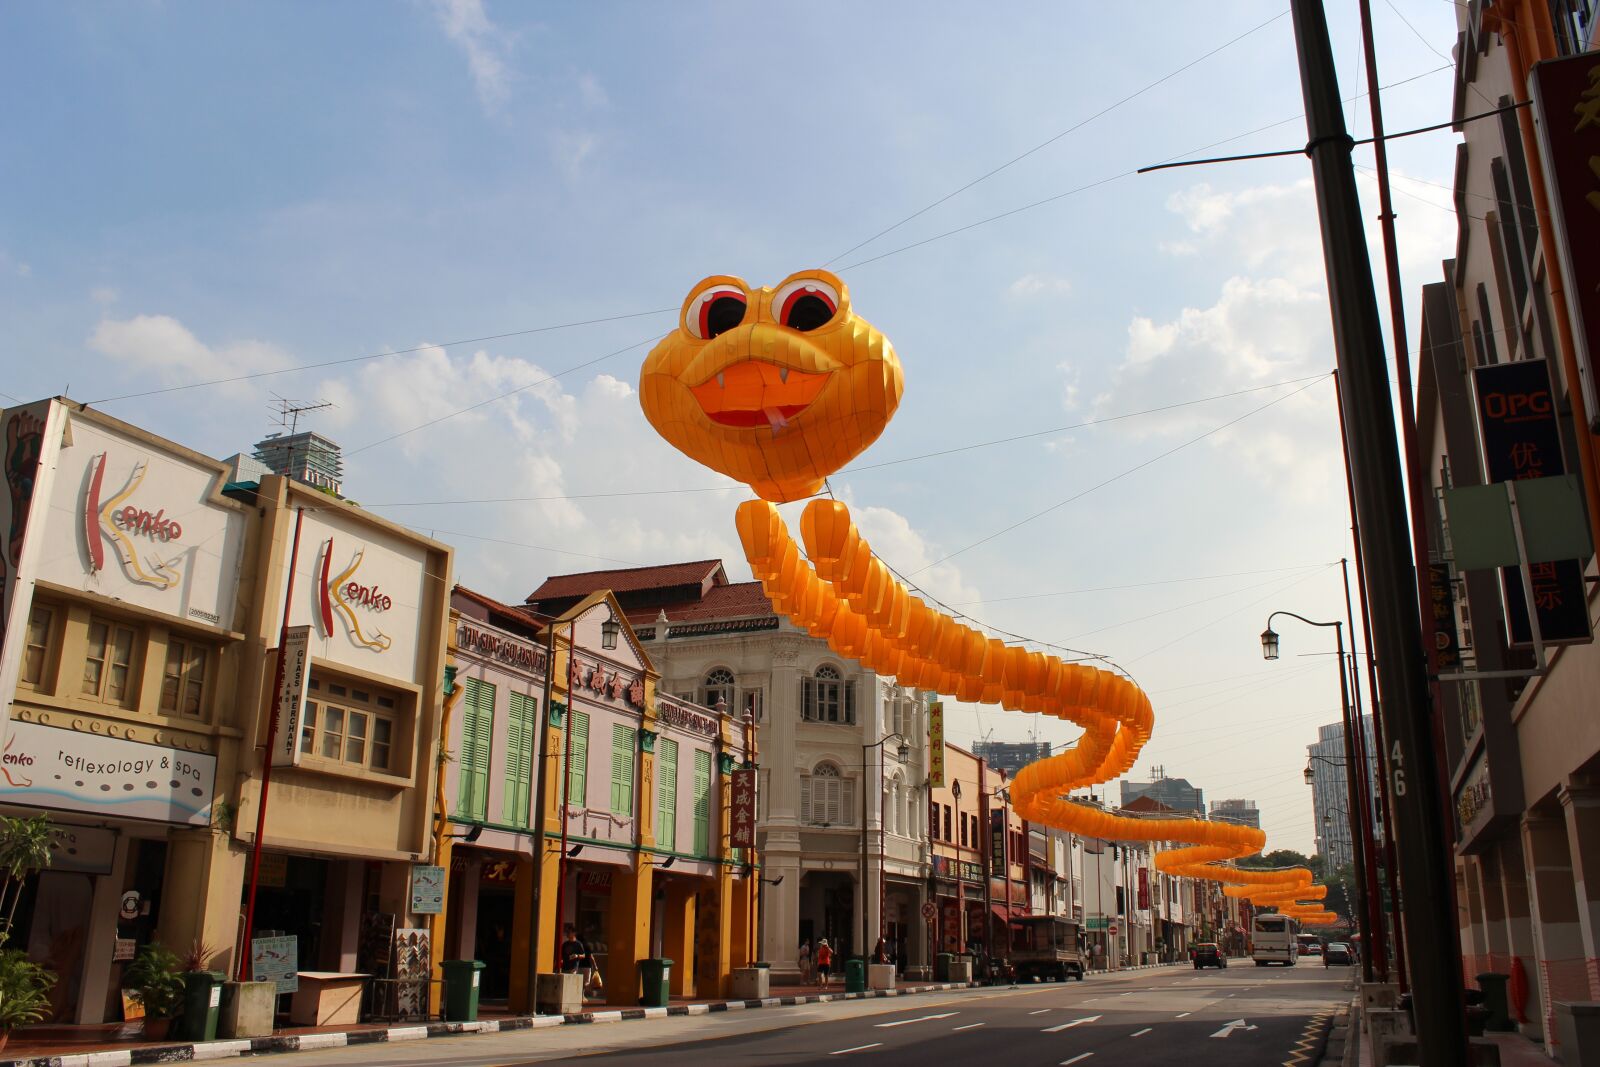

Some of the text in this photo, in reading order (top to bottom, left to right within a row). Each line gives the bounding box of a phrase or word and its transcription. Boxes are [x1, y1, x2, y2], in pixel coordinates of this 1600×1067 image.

[1485, 391, 1551, 418] OPG
[463, 625, 480, 647] TIN
[480, 633, 501, 654] SING
[294, 650, 303, 687] GLASS
[286, 694, 299, 756] MERCHANT
[58, 750, 201, 782] reflexology & spa
